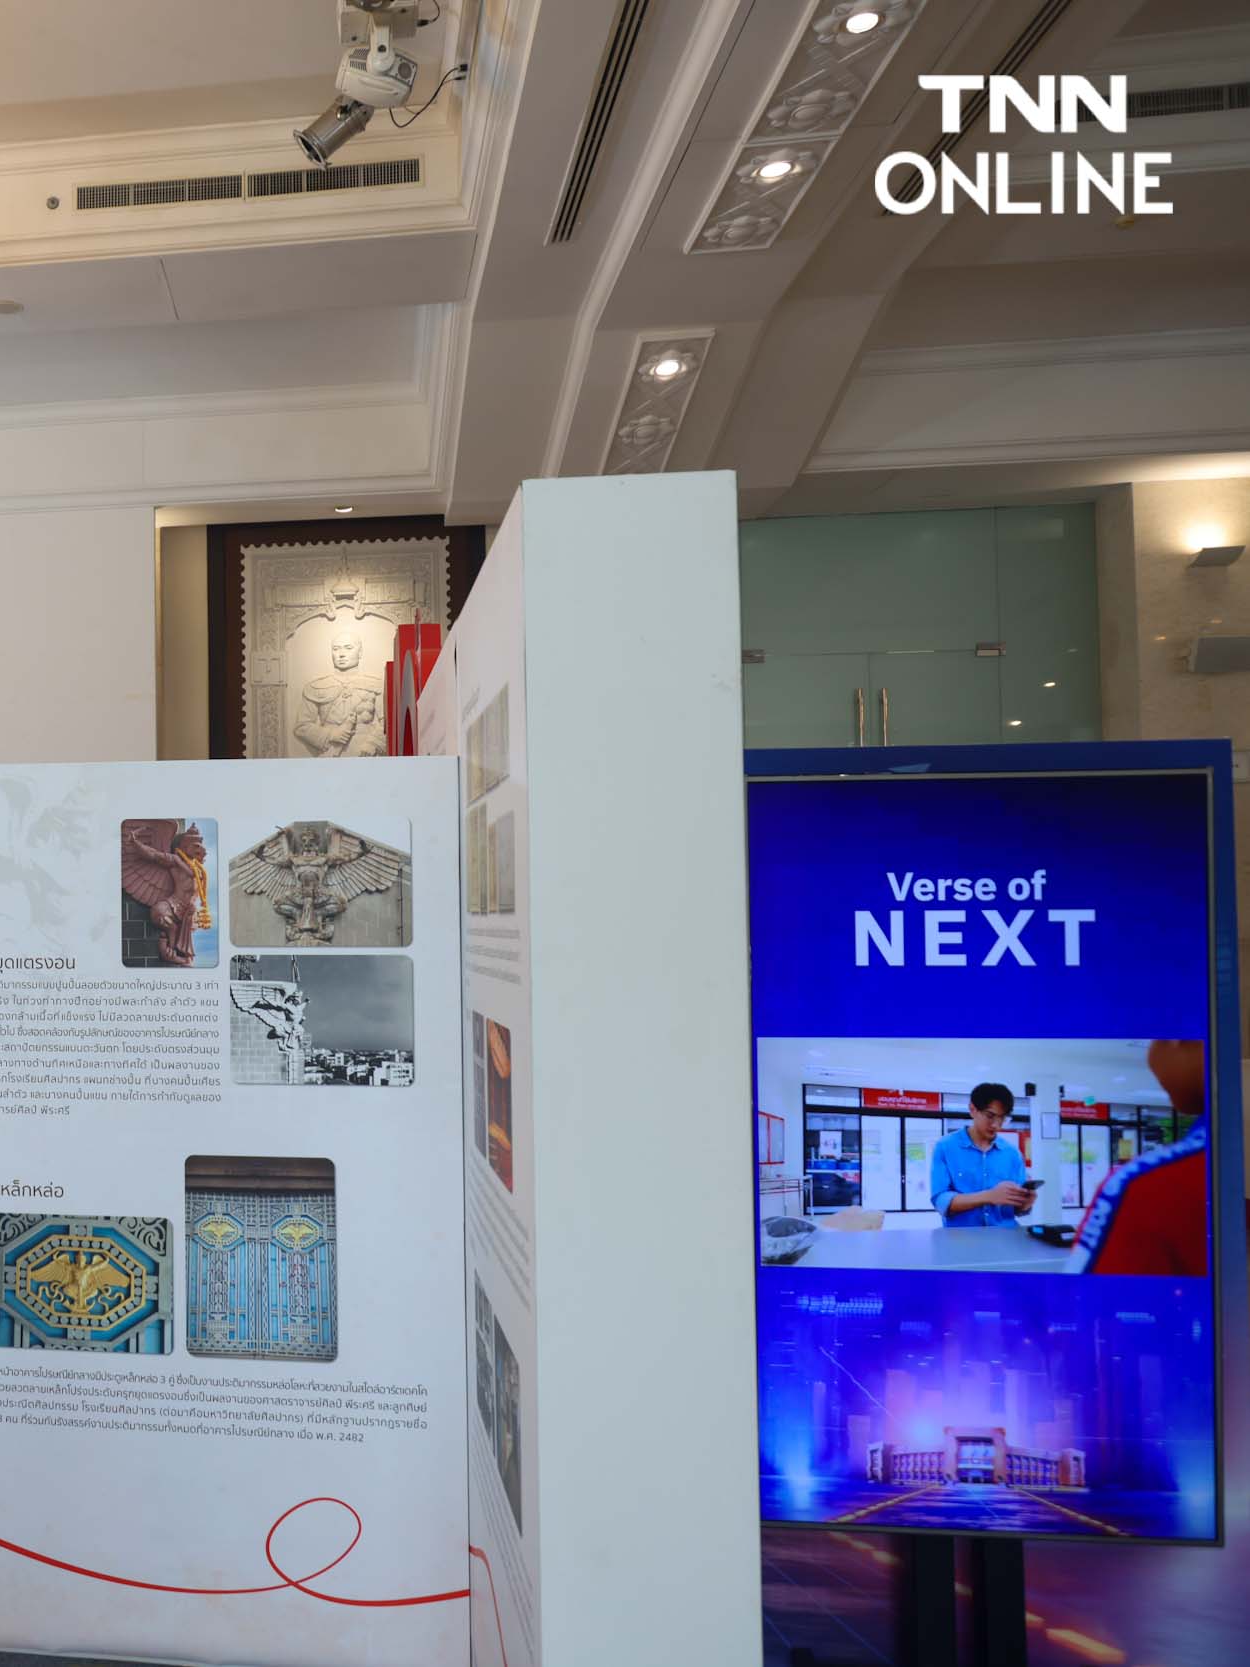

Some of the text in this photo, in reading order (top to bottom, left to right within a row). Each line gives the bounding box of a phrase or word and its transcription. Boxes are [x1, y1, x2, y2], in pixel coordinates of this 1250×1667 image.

[886, 869, 1047, 902] Verse of
[854, 909, 1096, 967] NEXT
[195, 981, 201, 990] 3
[204, 980, 219, 990] เท่า
[200, 999, 219, 1007] แขน
[5, 1415, 18, 1424] คน
[339, 1433, 364, 1442] 2482
